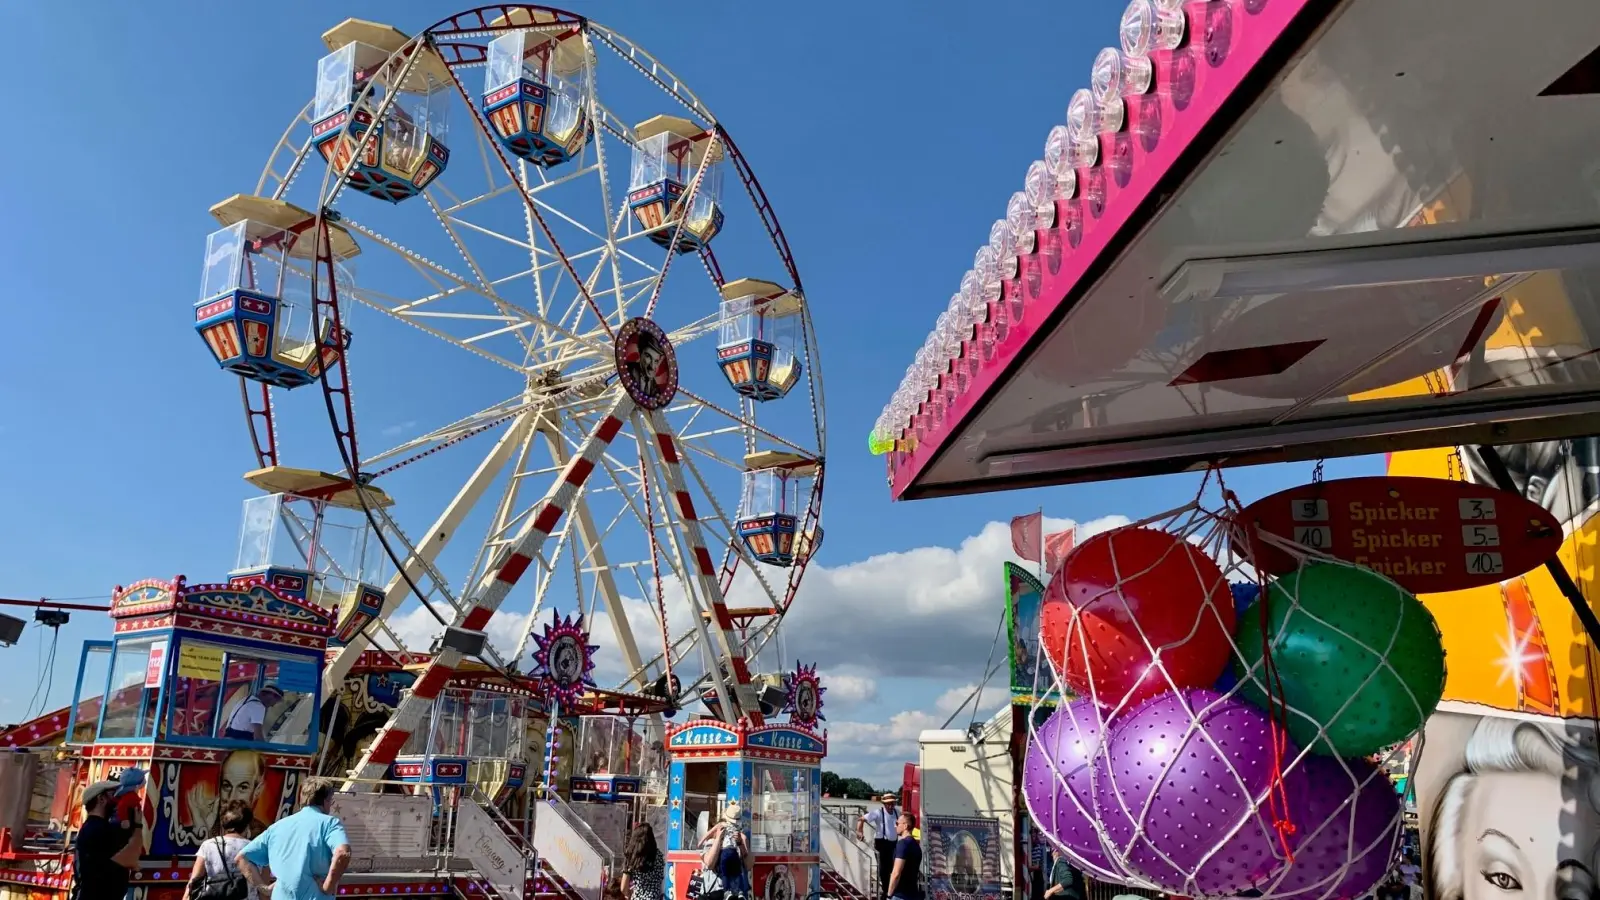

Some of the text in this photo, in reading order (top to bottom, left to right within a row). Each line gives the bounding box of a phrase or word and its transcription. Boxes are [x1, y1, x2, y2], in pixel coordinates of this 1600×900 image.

[1301, 501, 1318, 518] 5
[1350, 501, 1439, 525] Spicker
[1301, 528, 1323, 547] 10
[1352, 528, 1442, 552] Spicker
[685, 731, 722, 745] Kasse
[771, 731, 802, 749] Kasse
